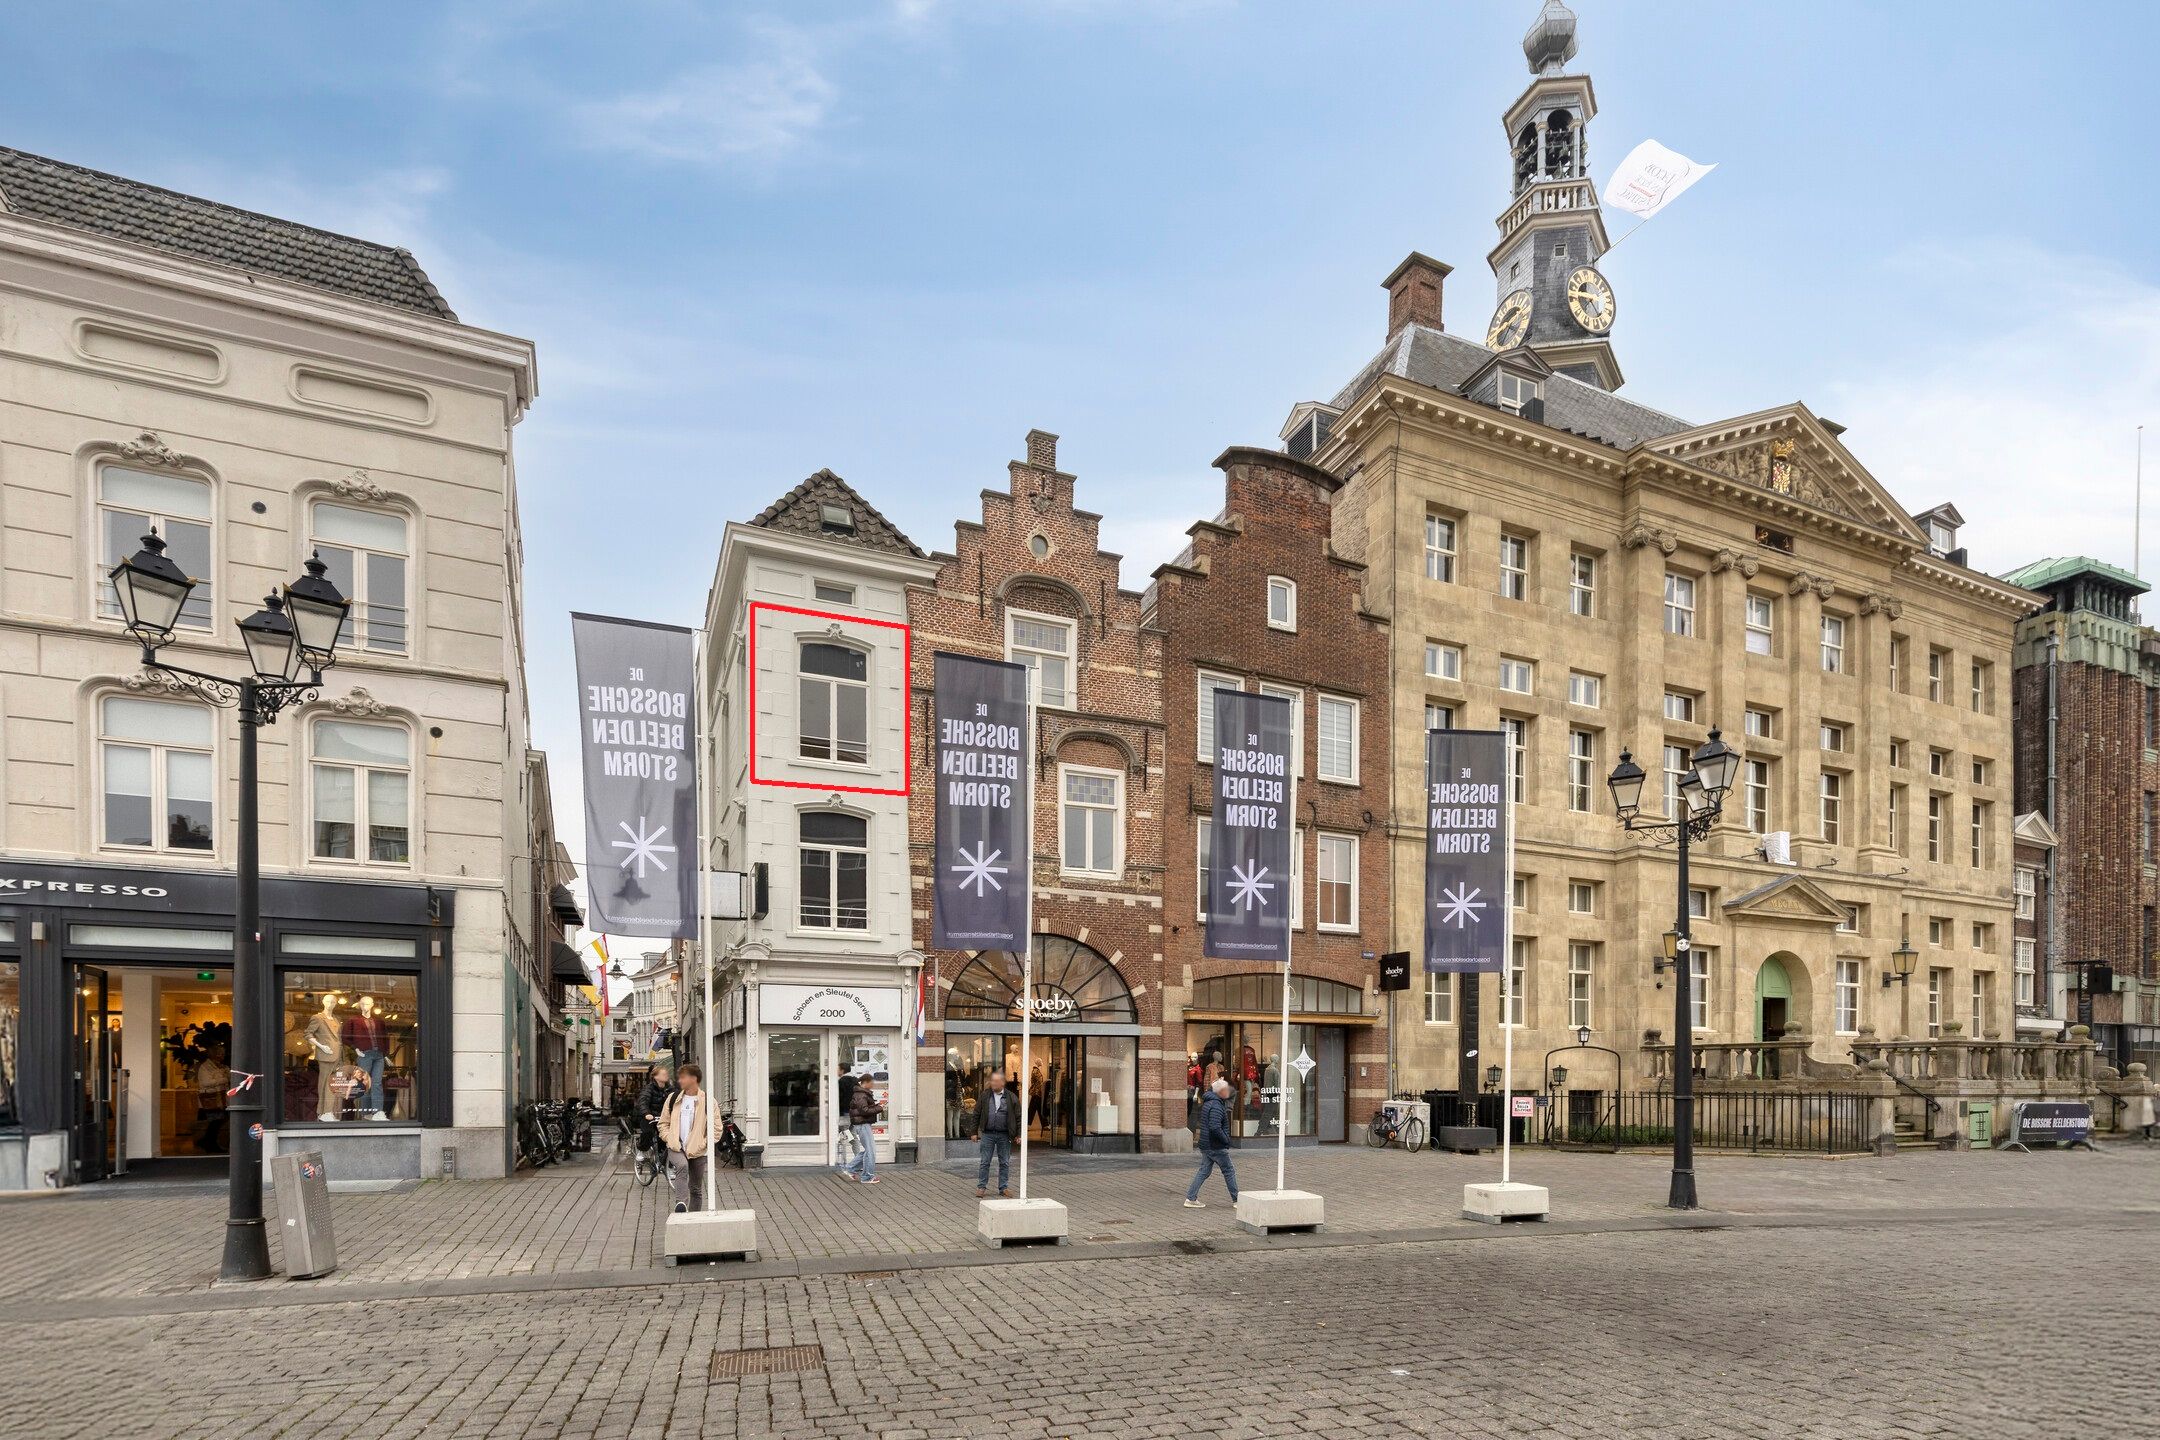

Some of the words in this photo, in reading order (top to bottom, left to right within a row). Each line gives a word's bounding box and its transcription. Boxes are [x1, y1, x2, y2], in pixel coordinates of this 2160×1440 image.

[1385, 966, 1404, 975] shoeby
[793, 996, 815, 1021] Schoen
[825, 988, 853, 1000] Sleutel
[853, 996, 871, 1023] Service
[820, 1009, 846, 1018] 2000
[1260, 1094, 1270, 1103] in
[1272, 1094, 1292, 1103] stle
[1269, 1117, 1290, 1127] shoy
[2022, 1117, 2031, 1128] DE
